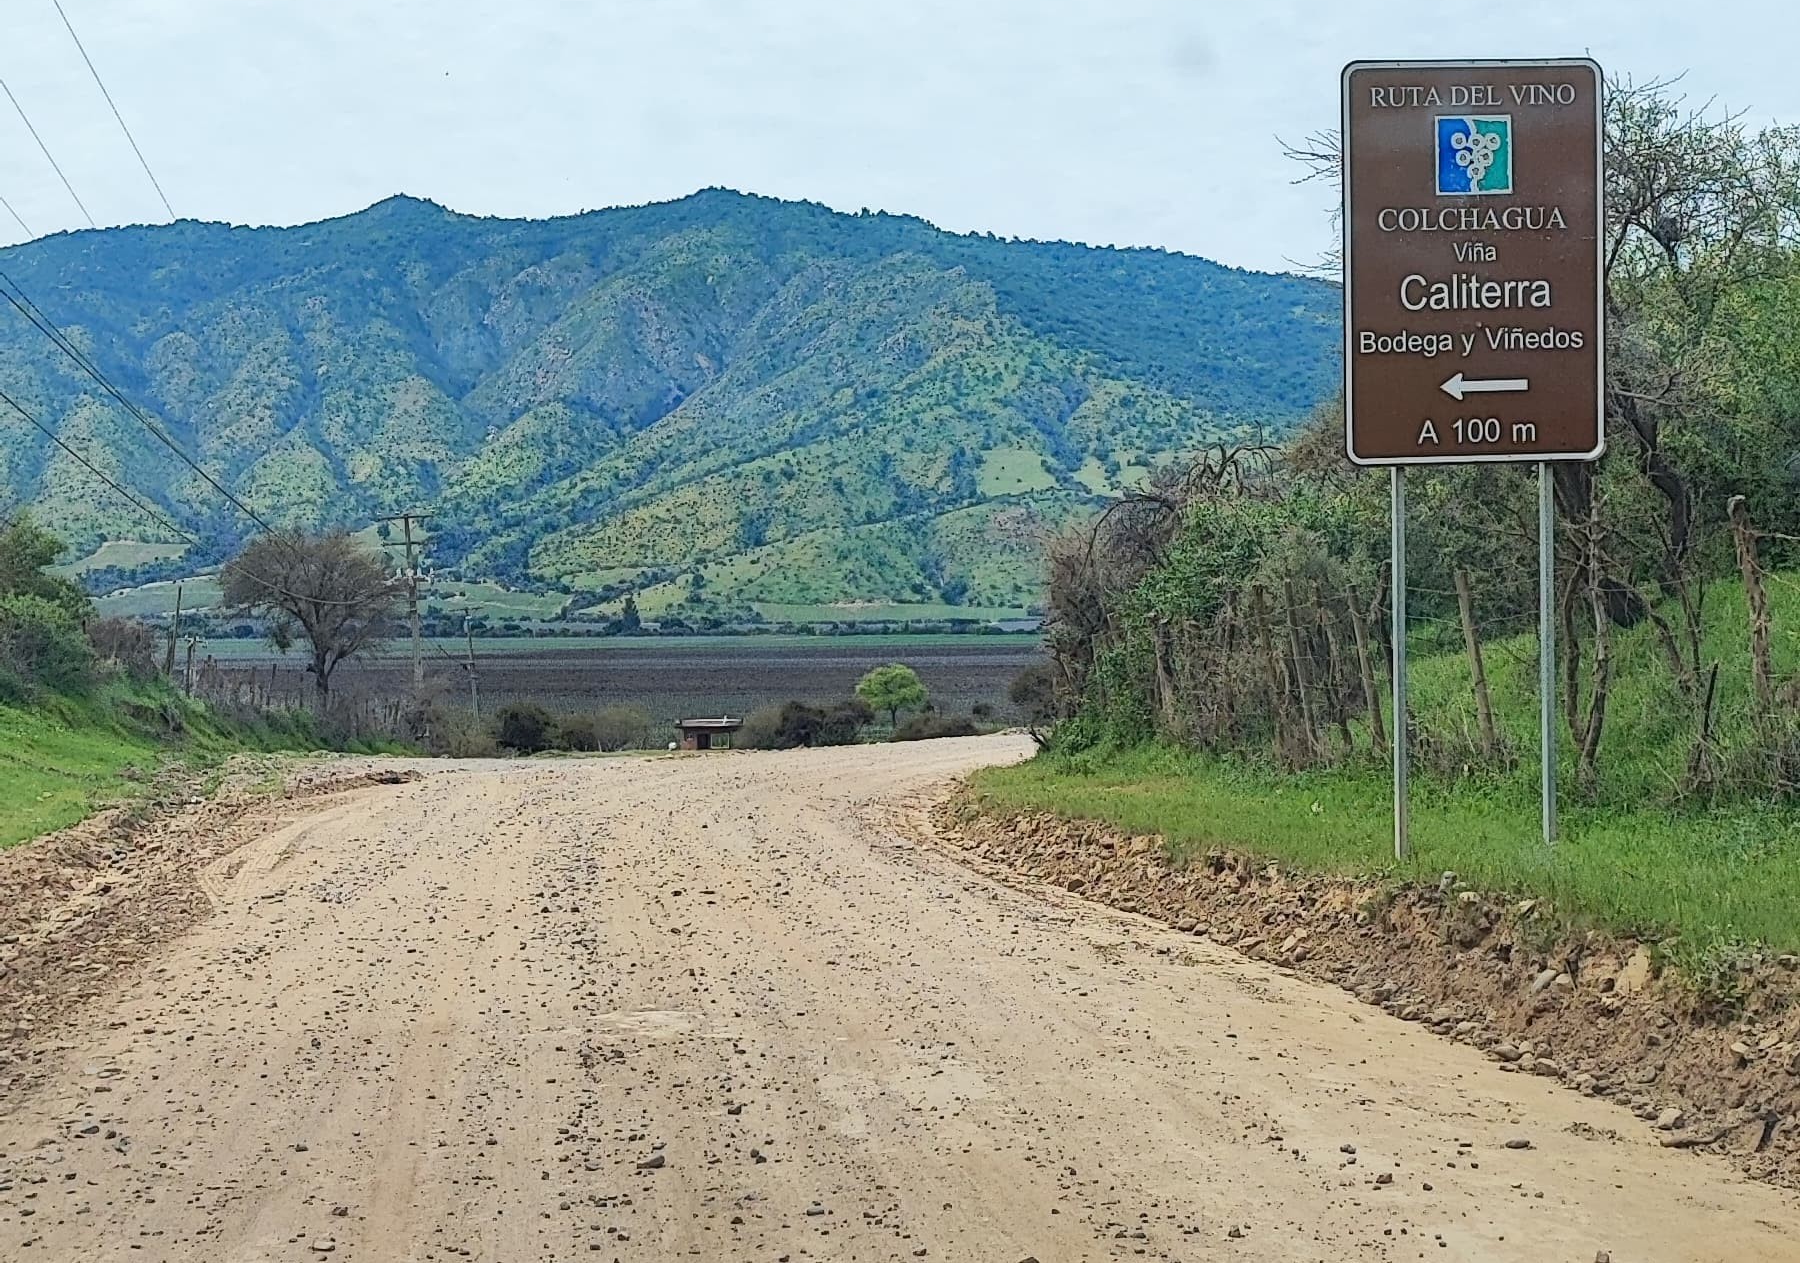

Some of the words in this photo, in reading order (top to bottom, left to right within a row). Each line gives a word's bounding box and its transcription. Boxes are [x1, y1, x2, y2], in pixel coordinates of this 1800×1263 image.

[1370, 85, 1443, 107] RUTA
[1450, 84, 1503, 106] DEL
[1509, 83, 1576, 105] VINO
[1378, 206, 1567, 232] COLCHAGUA
[1453, 242, 1497, 262] Viña
[1400, 273, 1551, 311] Caliterra
[1360, 329, 1453, 357] Bodega
[1461, 333, 1475, 356] y
[1485, 326, 1584, 350] Viñedos
[1417, 419, 1439, 444] A
[1452, 418, 1500, 443] 100
[1512, 423, 1536, 443] m
